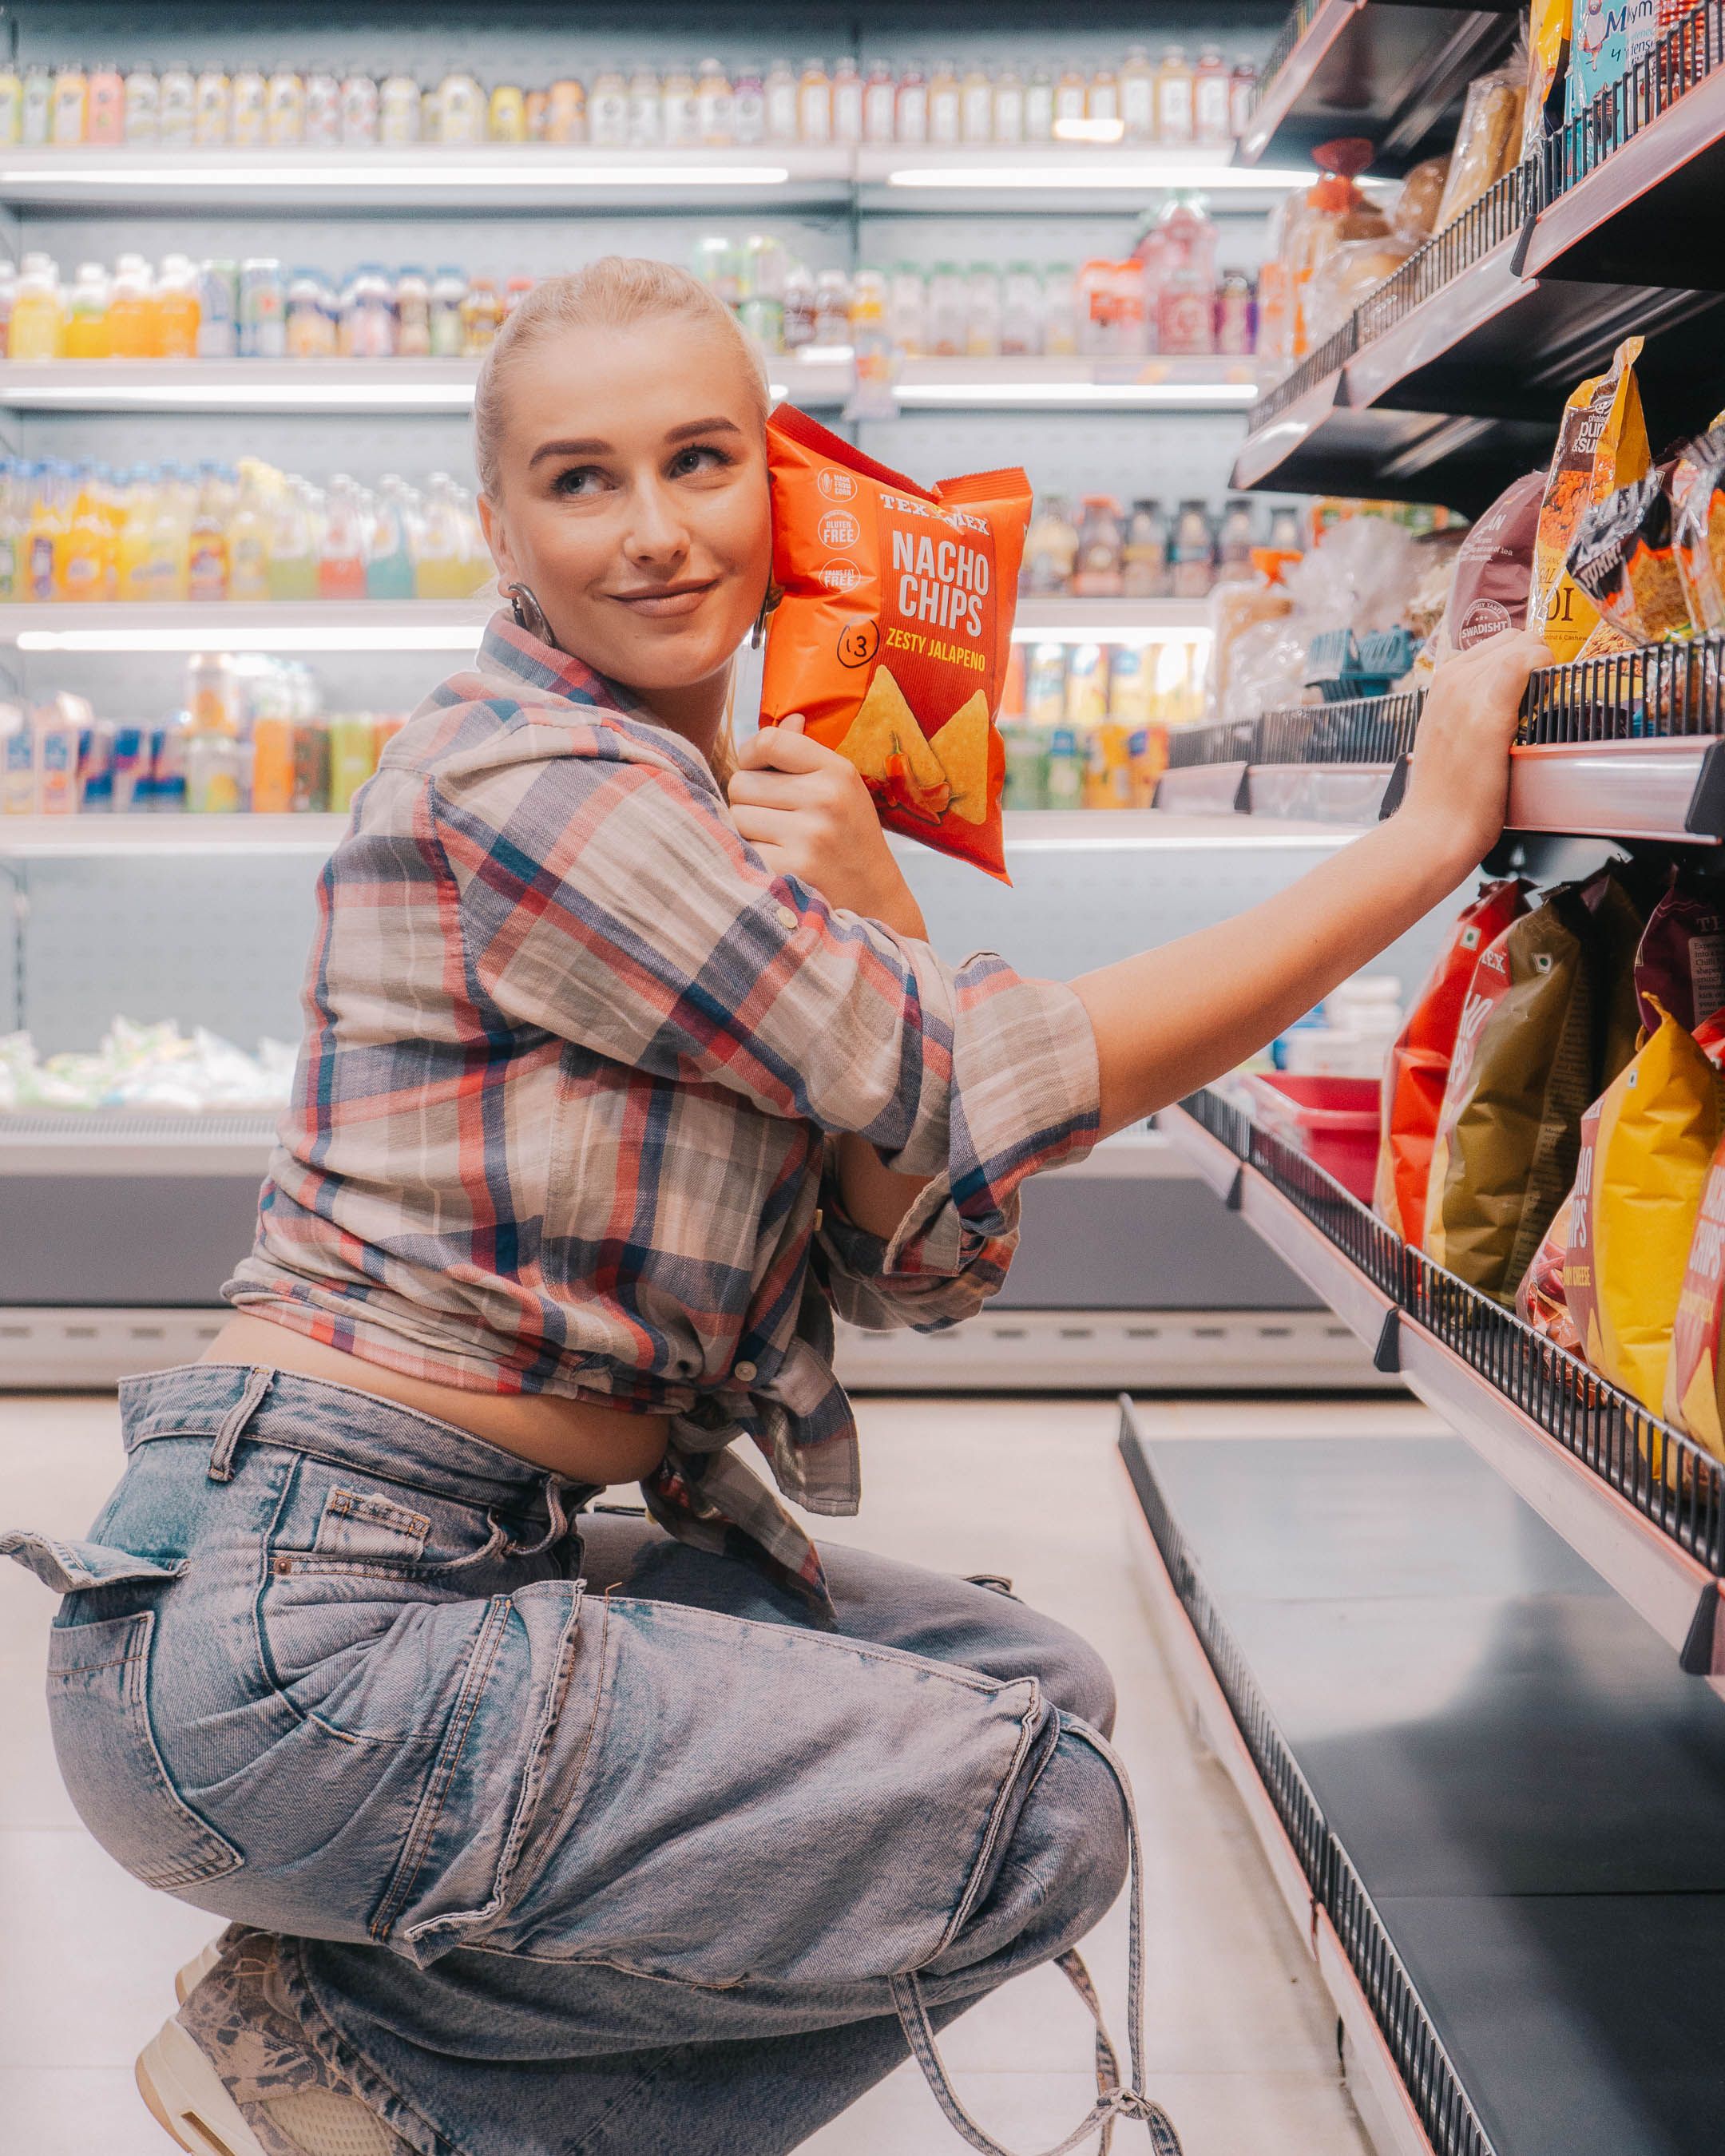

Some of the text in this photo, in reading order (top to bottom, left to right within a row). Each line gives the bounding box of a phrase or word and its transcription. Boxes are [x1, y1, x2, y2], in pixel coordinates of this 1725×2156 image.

[880, 493, 929, 517] TEX
[823, 529, 854, 544] FREE
[1501, 546, 1513, 557] tea
[893, 529, 989, 596] NACHO
[824, 575, 855, 588] FREE
[898, 574, 983, 637] CHIPS
[1461, 620, 1508, 639] SWADISHT
[886, 627, 986, 672] ZESTY JALAPENO
